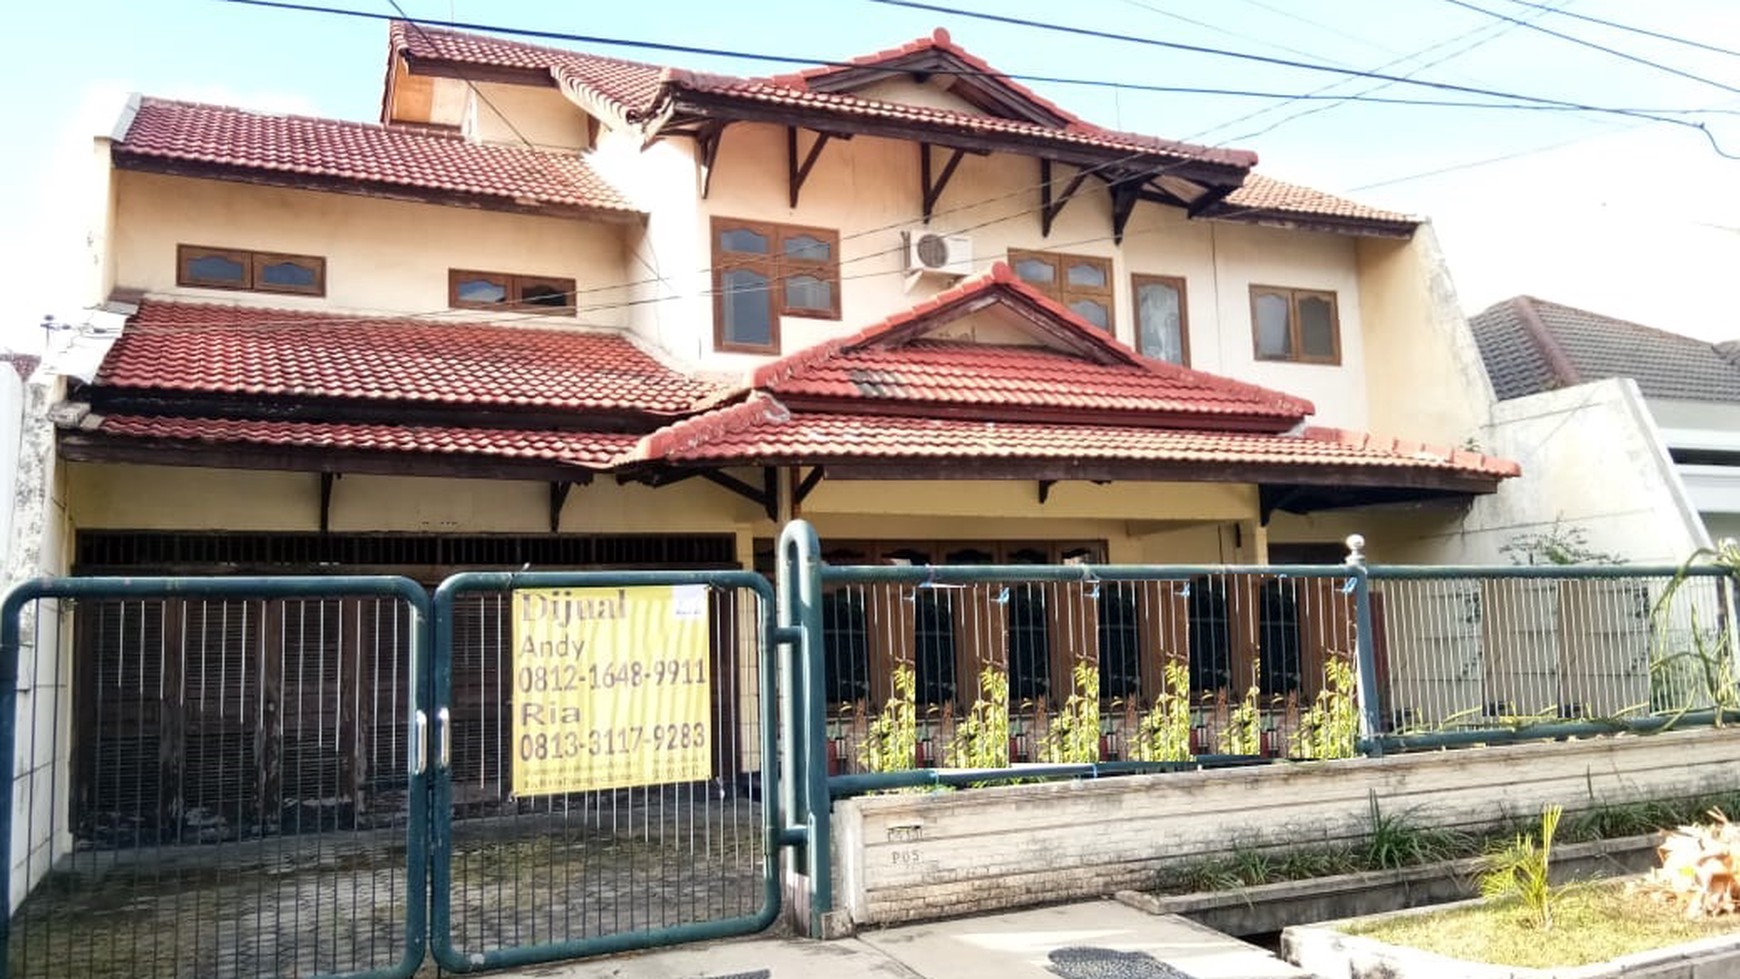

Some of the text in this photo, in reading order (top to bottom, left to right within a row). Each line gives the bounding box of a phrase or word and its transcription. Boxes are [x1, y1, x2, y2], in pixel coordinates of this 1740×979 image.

[522, 589, 625, 627] Dijual
[519, 635, 584, 661] Andy
[519, 659, 706, 693] 0812-1648-9911
[522, 702, 580, 726] Ria
[520, 723, 705, 761] 0813-3117-9283
